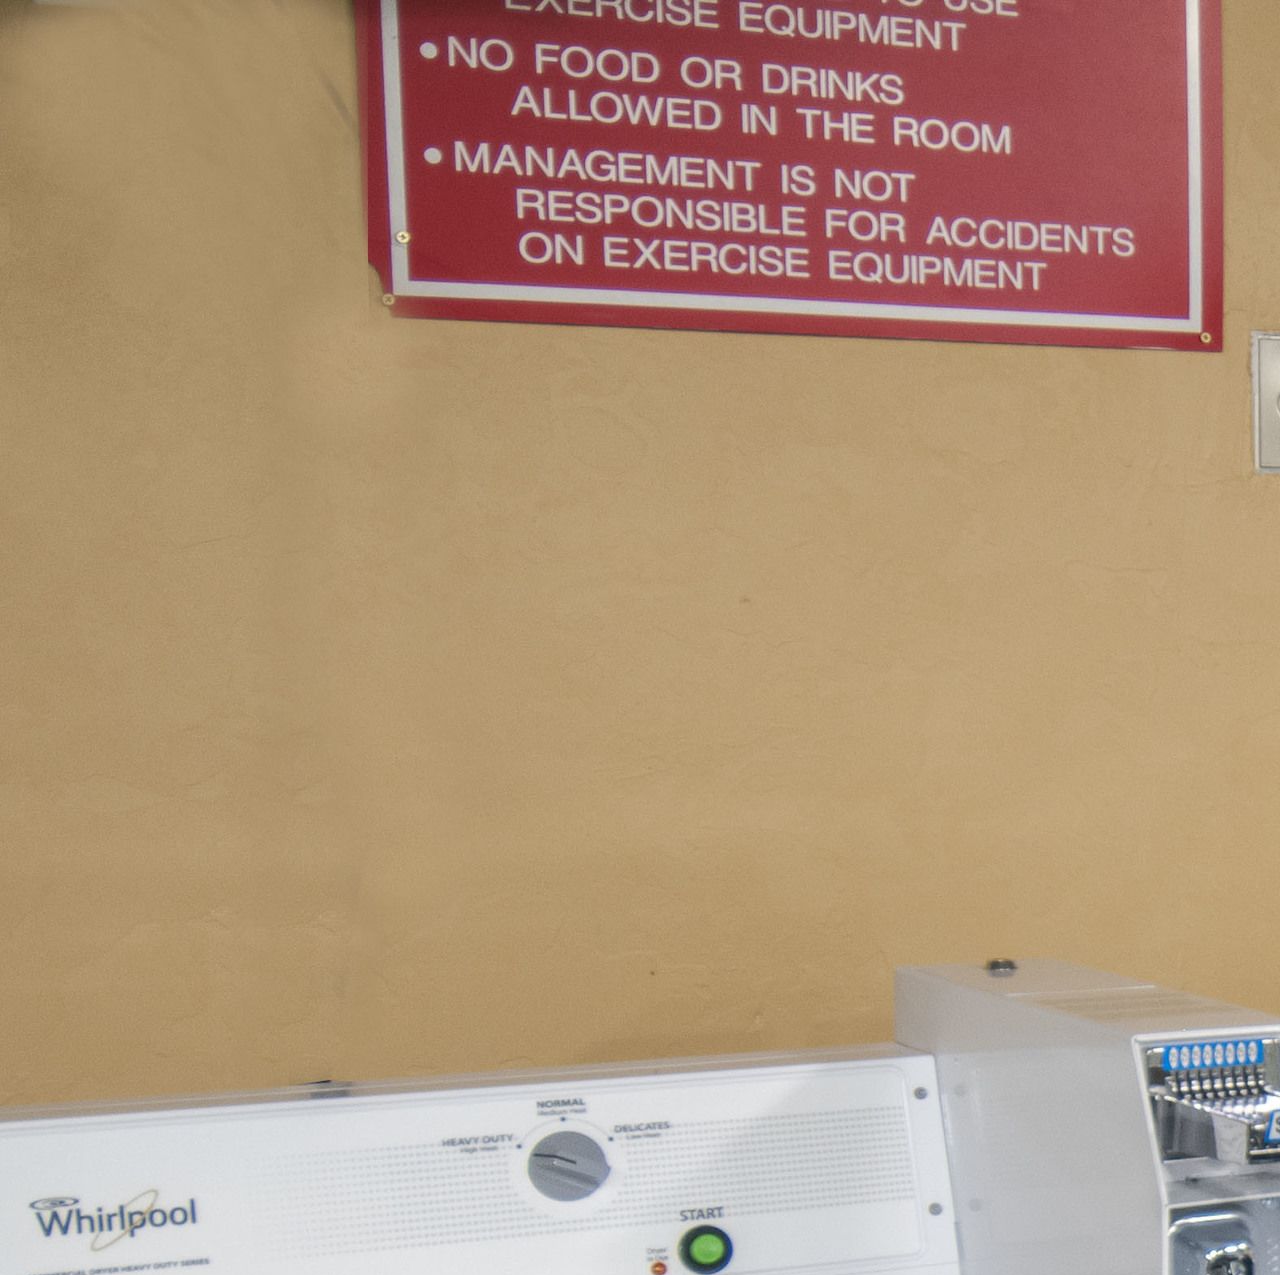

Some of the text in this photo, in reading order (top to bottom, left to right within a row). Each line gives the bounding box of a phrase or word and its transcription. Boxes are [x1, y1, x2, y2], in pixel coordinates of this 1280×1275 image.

[740, 0, 969, 51] EQUIPMENT
[448, 37, 904, 105] NO FOOD OR DRINKS
[512, 86, 1011, 154] ALLOWED IN THE ROOM
[455, 141, 916, 203] MANAGEMENT IS NOT
[517, 189, 1135, 257] RESPONSIBLE FOR ACCIDENTS
[519, 232, 1048, 290] ON EXERCISE EQUIPMENT
[536, 1098, 587, 1109] NORMAL
[442, 1133, 514, 1148] HEAVY DUTY
[614, 1121, 671, 1134] DELICATES
[34, 1197, 198, 1238] Whirlpool
[679, 1206, 724, 1222] START
[153, 1260, 178, 1270] DUTY
